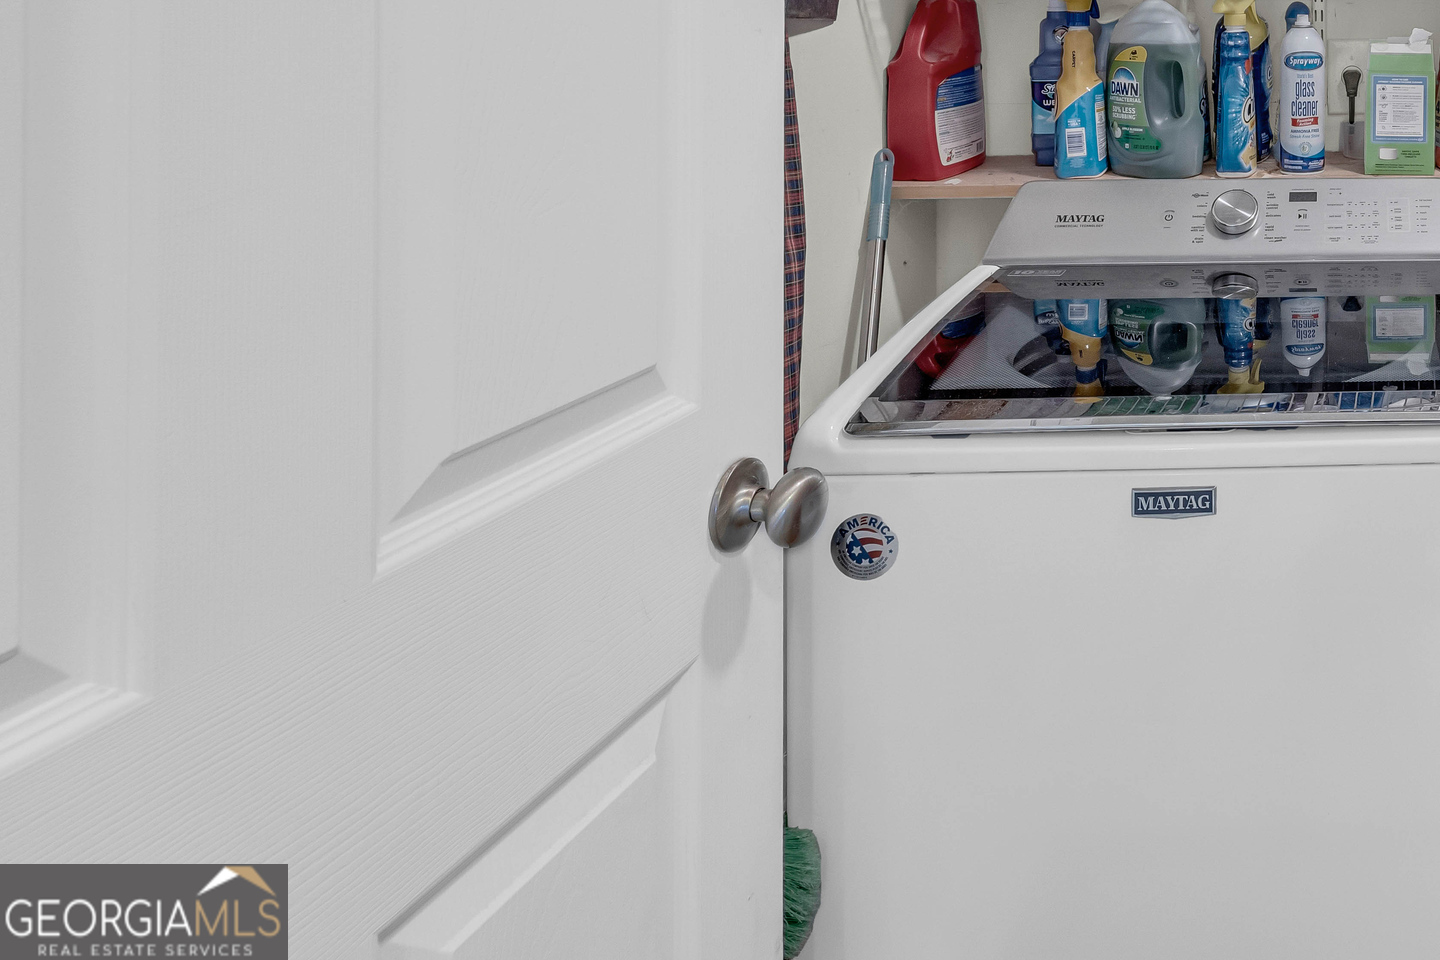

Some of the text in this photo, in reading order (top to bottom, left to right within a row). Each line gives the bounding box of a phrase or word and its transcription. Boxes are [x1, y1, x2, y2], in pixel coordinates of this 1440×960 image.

[1289, 56, 1322, 67] Sprayway
[1111, 81, 1139, 97] DAWN
[1295, 79, 1315, 99] glass
[1110, 95, 1142, 103] ANTIBACTERIAL
[1122, 106, 1136, 114] LESS
[1291, 100, 1318, 117] cleaner
[1055, 214, 1105, 222] MAYTAG
[1137, 494, 1211, 511] MAYTAG
[838, 516, 895, 545] AMERICA
